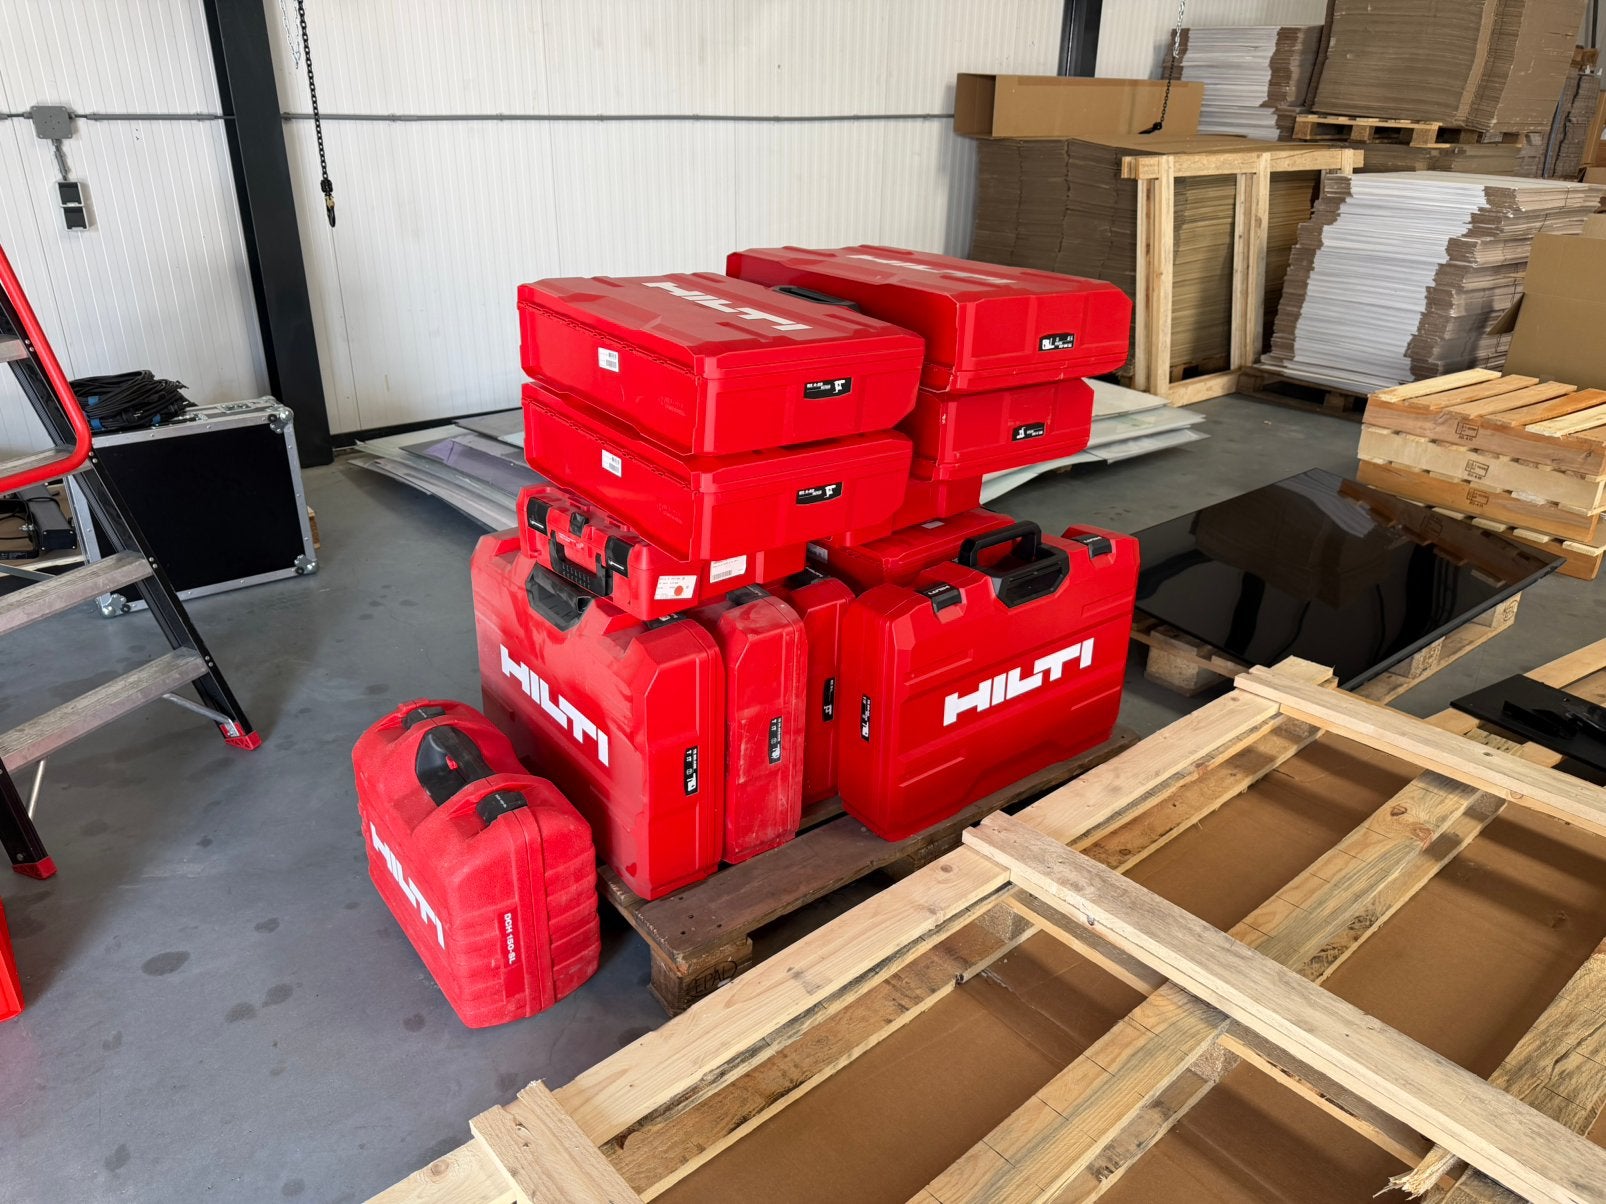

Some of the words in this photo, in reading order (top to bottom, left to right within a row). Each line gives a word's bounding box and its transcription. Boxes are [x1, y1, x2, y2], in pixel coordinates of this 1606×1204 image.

[641, 281, 813, 331] HILTI
[500, 643, 609, 768] HILTI
[943, 637, 1095, 727] HILTI
[370, 821, 445, 951] HILTI
[504, 912, 513, 934] DCH
[507, 934, 516, 965] 150-SL
